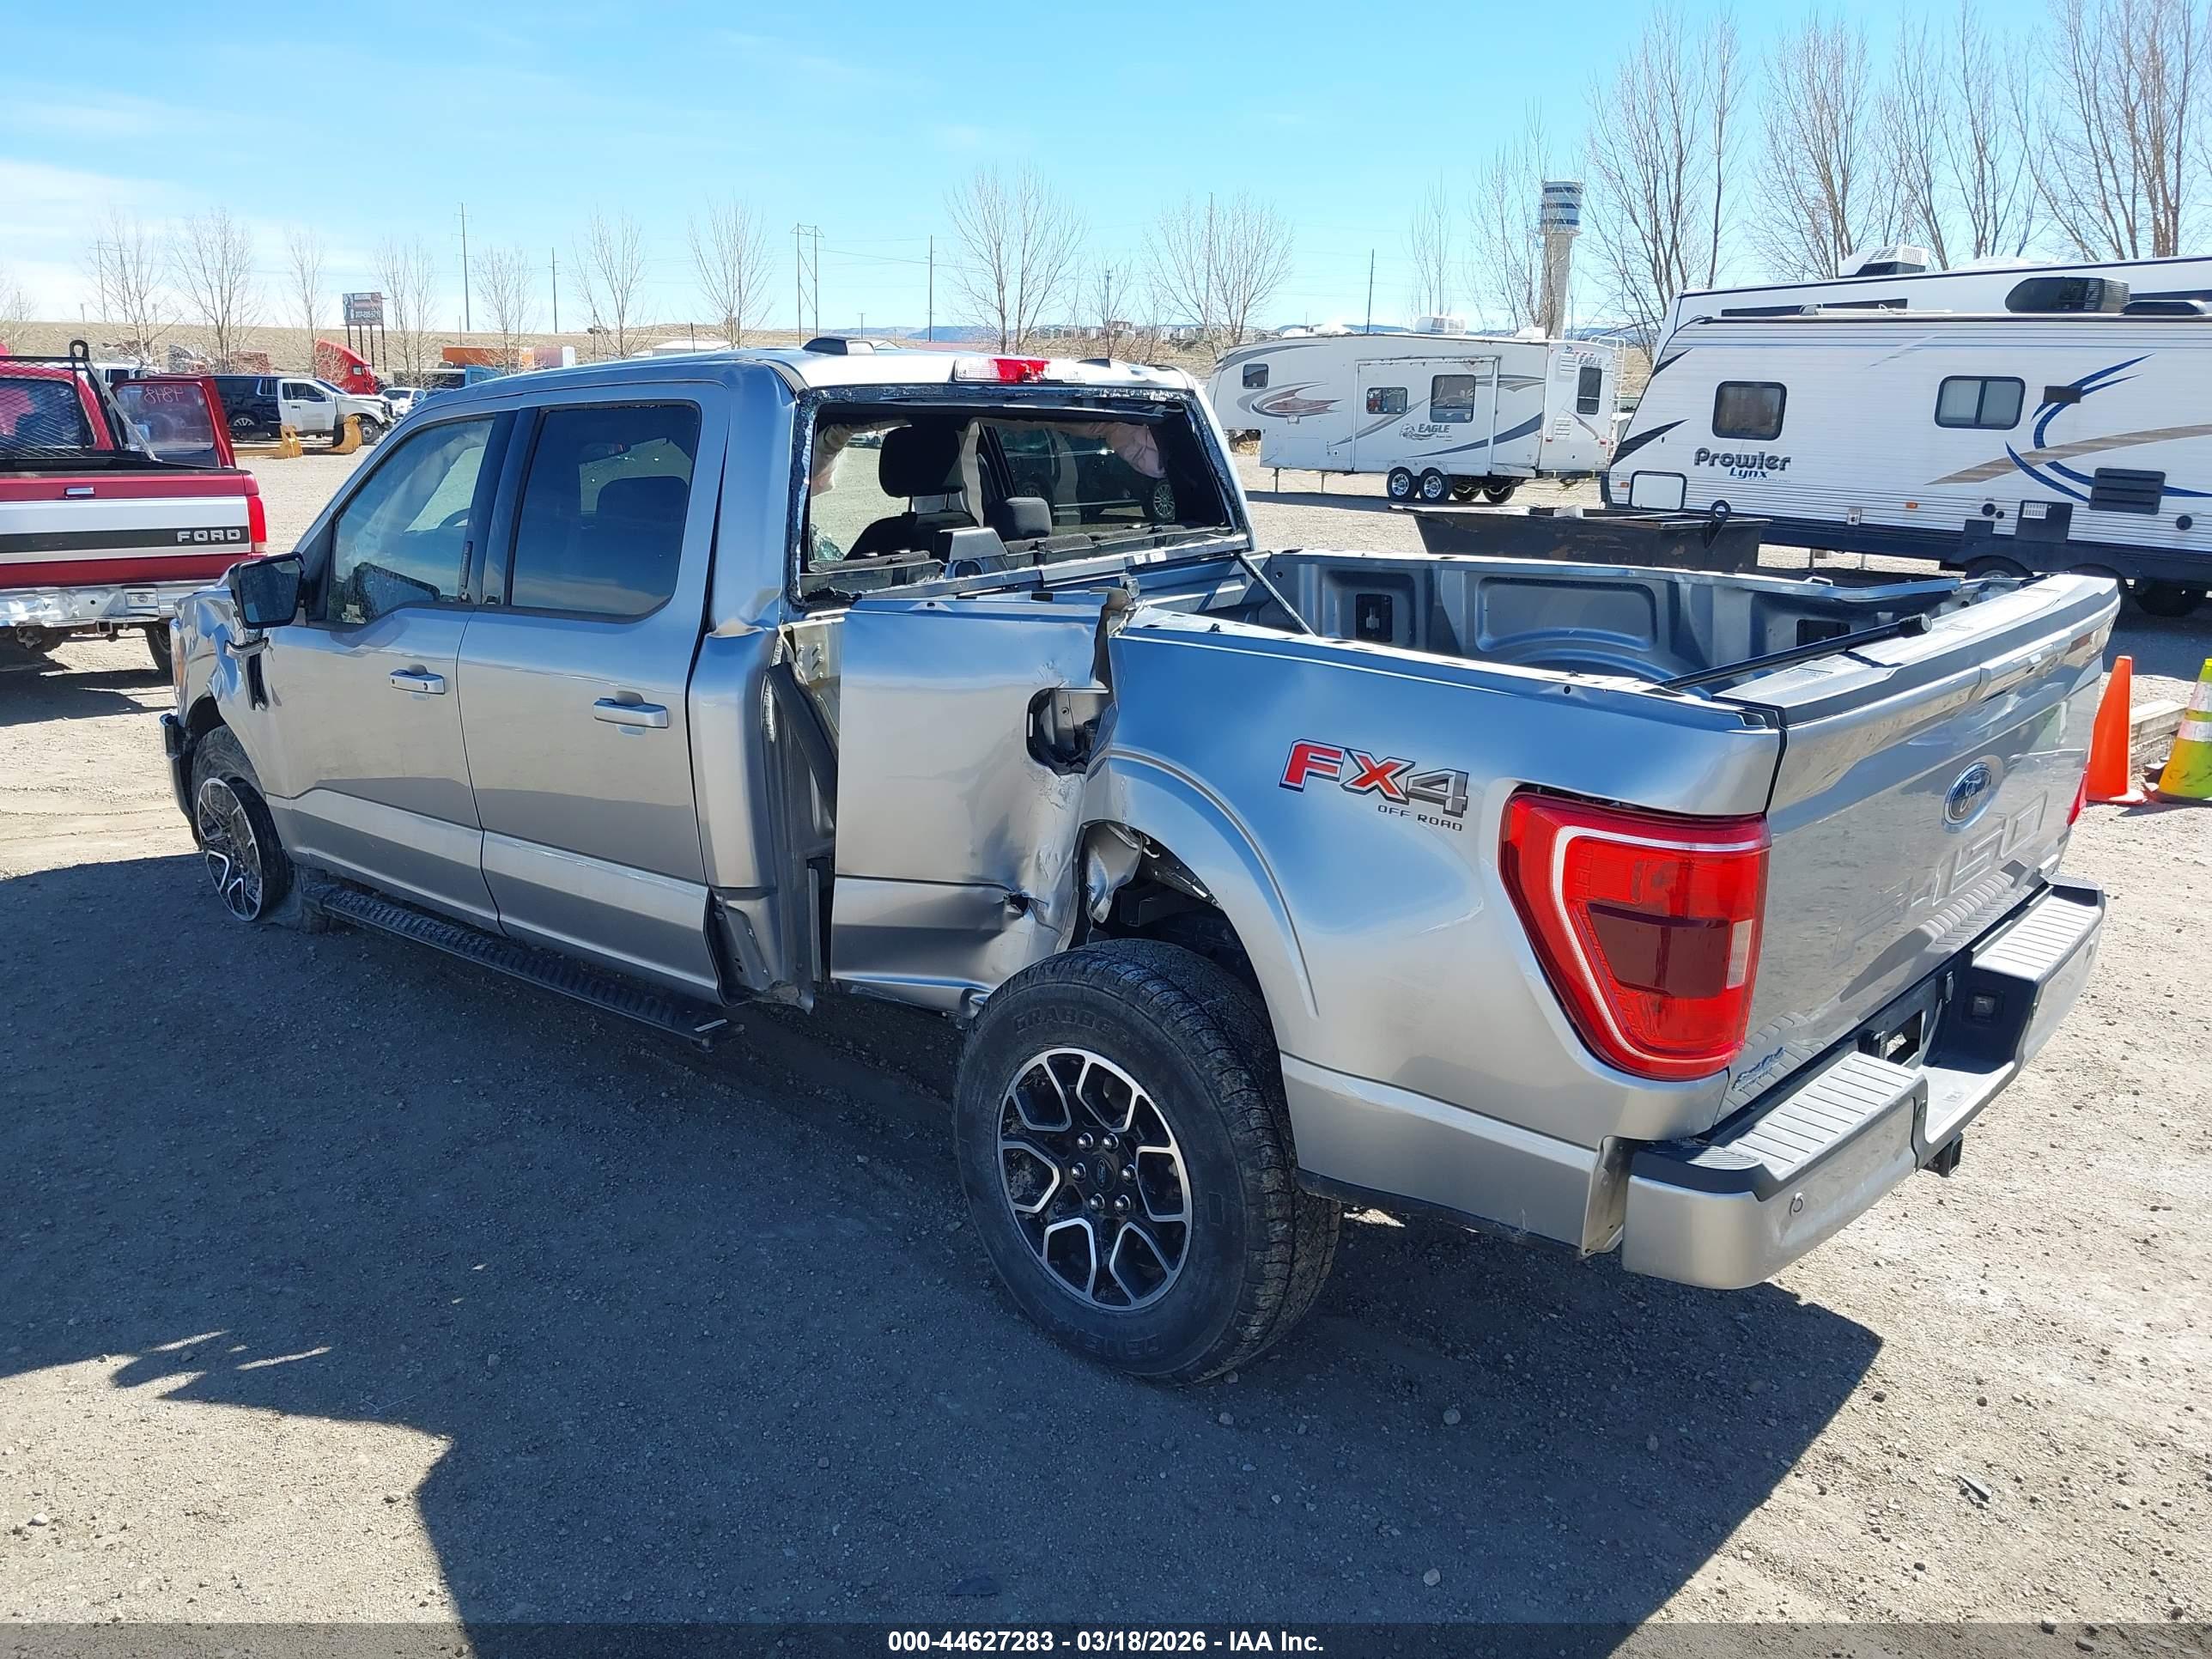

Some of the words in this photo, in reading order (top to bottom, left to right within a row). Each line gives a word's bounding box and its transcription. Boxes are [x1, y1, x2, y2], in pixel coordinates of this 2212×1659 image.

[1418, 423, 1450, 434] EAGLE
[1693, 447, 1791, 471] Prowler
[1729, 466, 1769, 479] Lynx
[177, 529, 240, 543] FORD
[1279, 738, 1469, 818] FX4
[1377, 804, 1412, 817] OFF
[1417, 814, 1463, 832] ROAD
